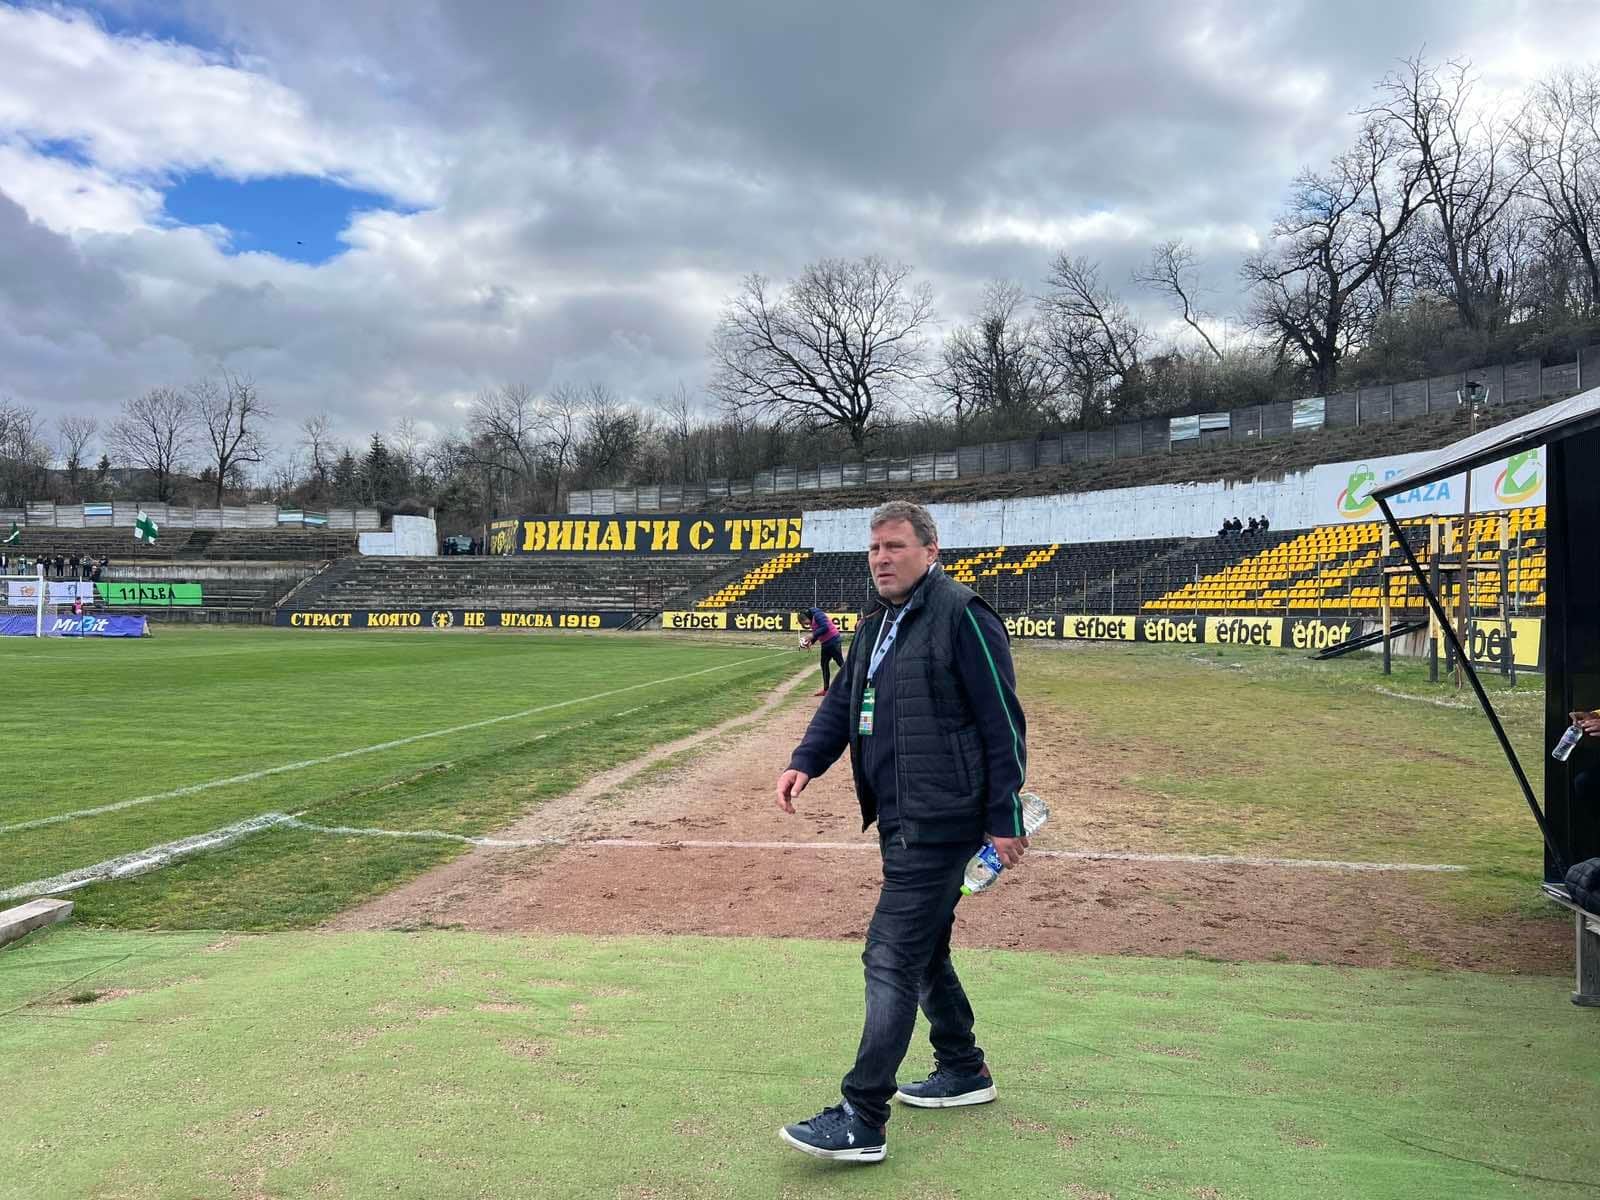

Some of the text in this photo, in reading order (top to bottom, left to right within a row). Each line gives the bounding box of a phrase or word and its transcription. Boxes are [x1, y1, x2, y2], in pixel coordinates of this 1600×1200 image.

[522, 520, 681, 551] ВИНАГИ
[689, 520, 715, 551] С
[724, 518, 802, 550] ТЕБ
[51, 615, 109, 632] MrBit
[290, 612, 601, 628] СТРАСТ КОЯТО НЕ УГАСВА 1919
[671, 612, 719, 628] efbet
[735, 613, 783, 630] efbet
[1004, 616, 1056, 637] efbet
[1073, 617, 1127, 639] efbet
[1143, 617, 1197, 643] efbet
[1215, 619, 1272, 646] efbet
[1292, 619, 1350, 649] efbet
